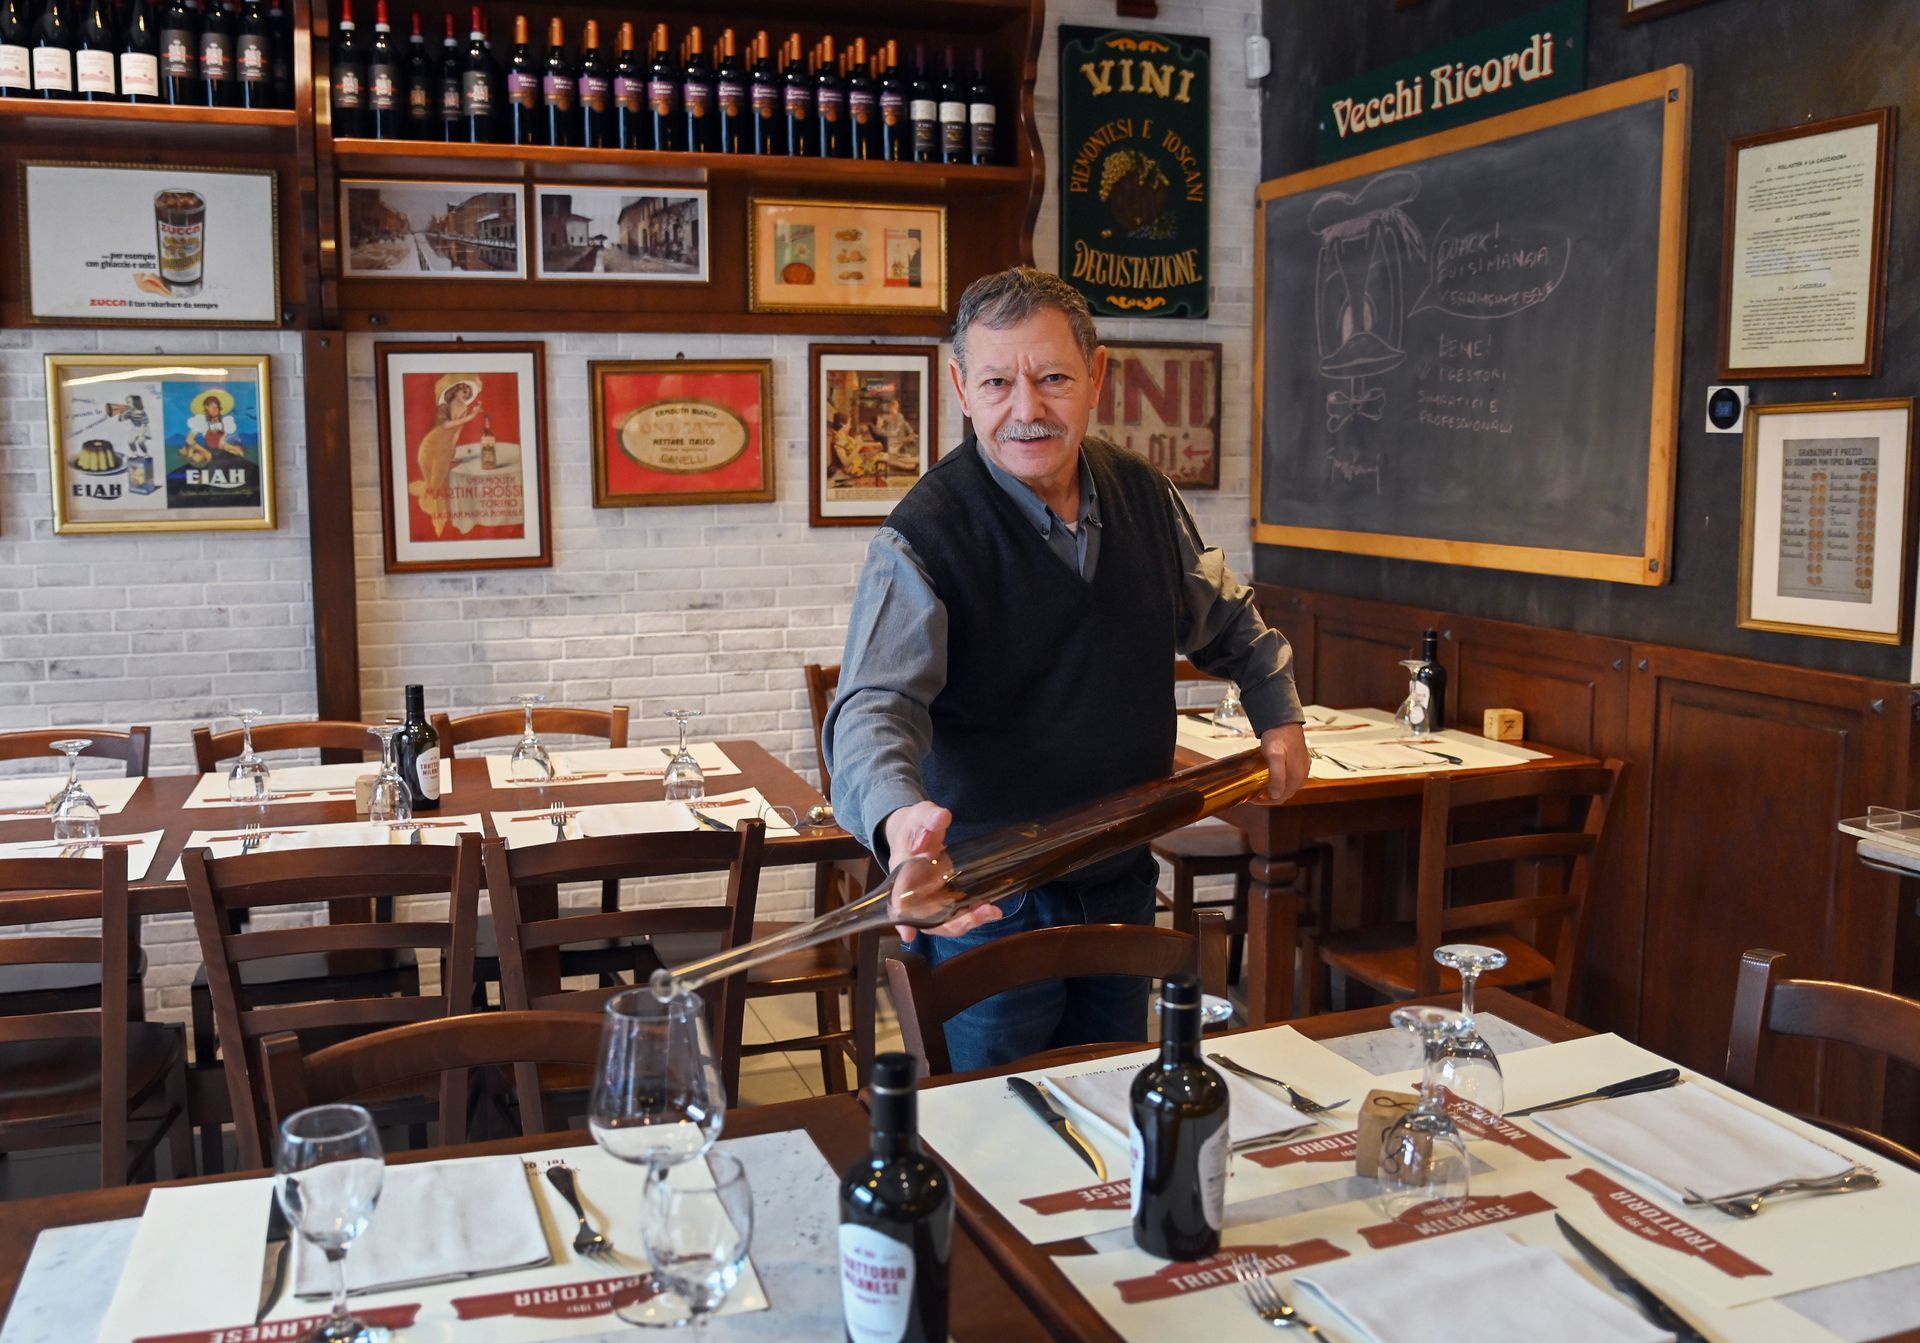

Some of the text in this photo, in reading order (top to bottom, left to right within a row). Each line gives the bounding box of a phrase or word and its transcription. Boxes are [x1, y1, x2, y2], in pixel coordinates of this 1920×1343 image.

[1080, 58, 1196, 104] VINI
[1332, 32, 1554, 139] Vecchi Ricordi
[1142, 119, 1153, 138] E
[160, 224, 201, 236] ZUCCA
[1072, 240, 1203, 289] DEGUSTAZIONE
[89, 299, 127, 307] ZUCCA
[1097, 358, 1206, 428] INI
[1503, 720, 1516, 735] 7
[1414, 1204, 1517, 1235] MILANESE
[1609, 1190, 1717, 1253] TRATTORIA
